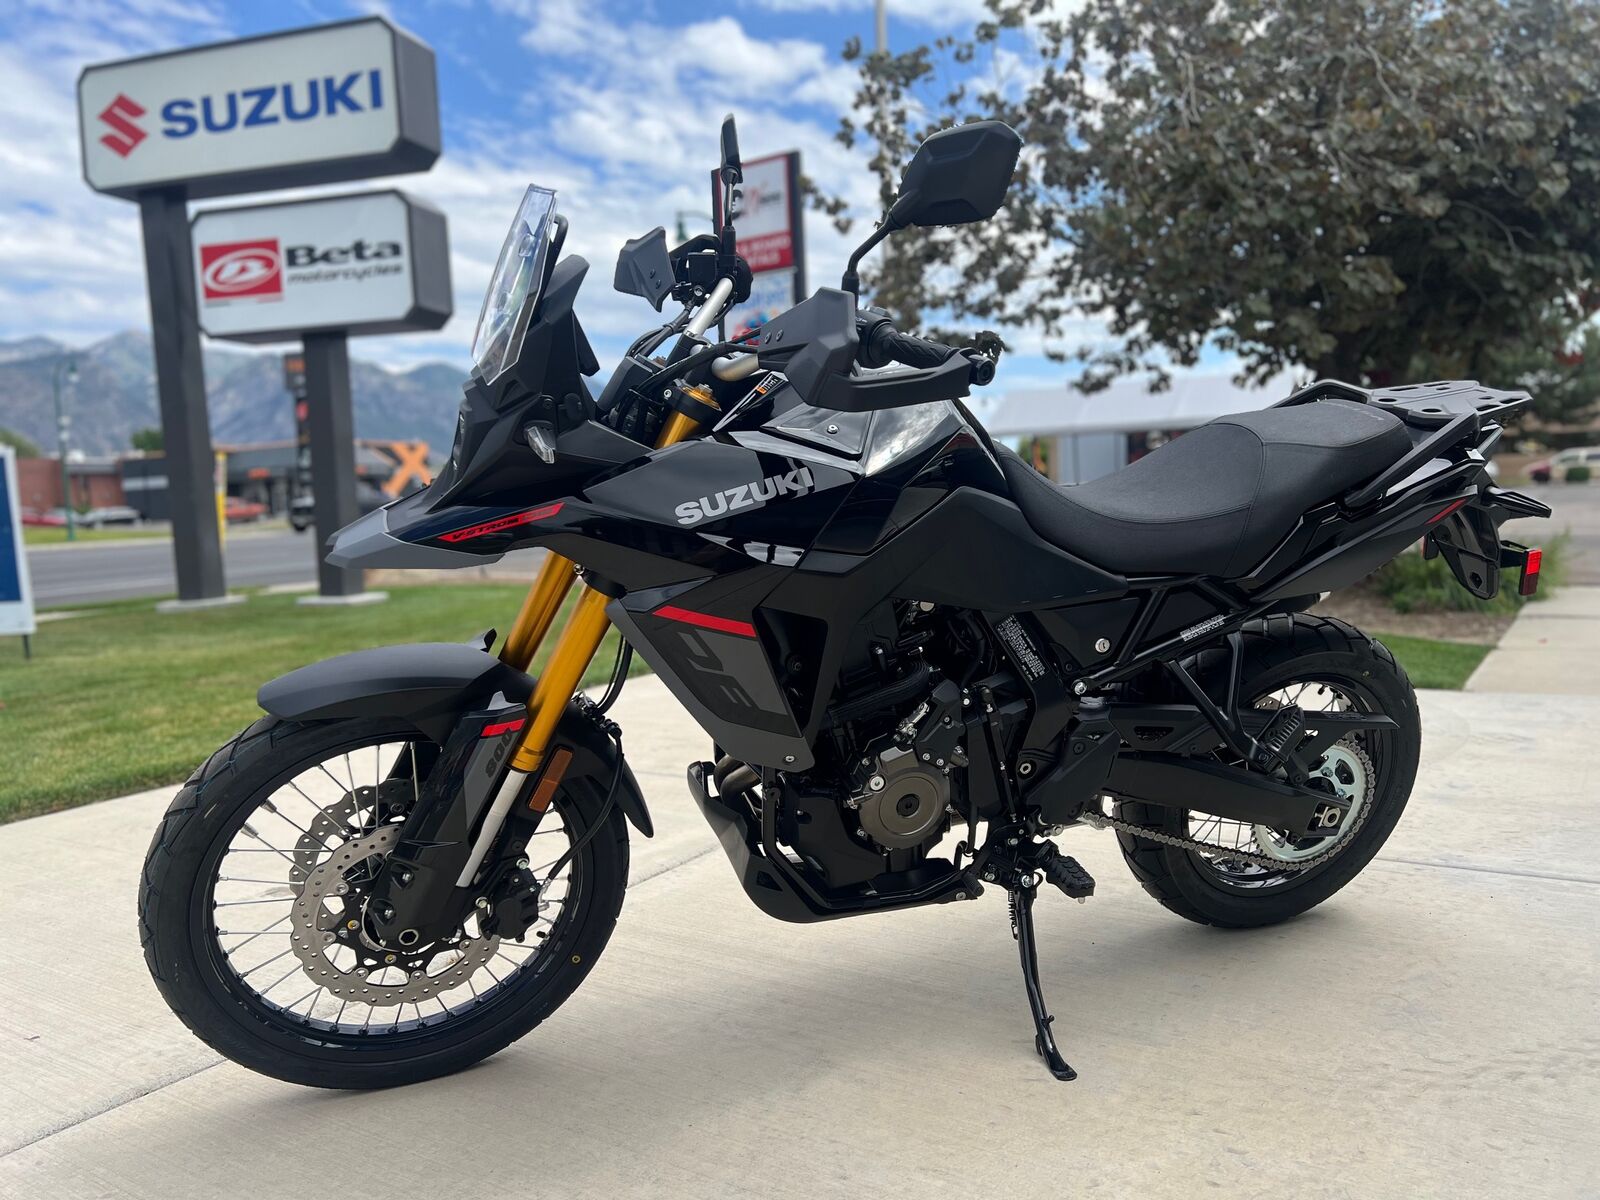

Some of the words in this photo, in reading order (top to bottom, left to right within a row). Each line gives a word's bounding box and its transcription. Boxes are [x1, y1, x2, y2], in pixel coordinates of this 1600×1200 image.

[161, 69, 384, 139] SUZUKI
[285, 239, 402, 267] Beta
[287, 264, 402, 285] motorcycles
[674, 466, 815, 525] SUZUKI
[452, 517, 520, 540] V-STROM
[484, 727, 513, 778] 800
